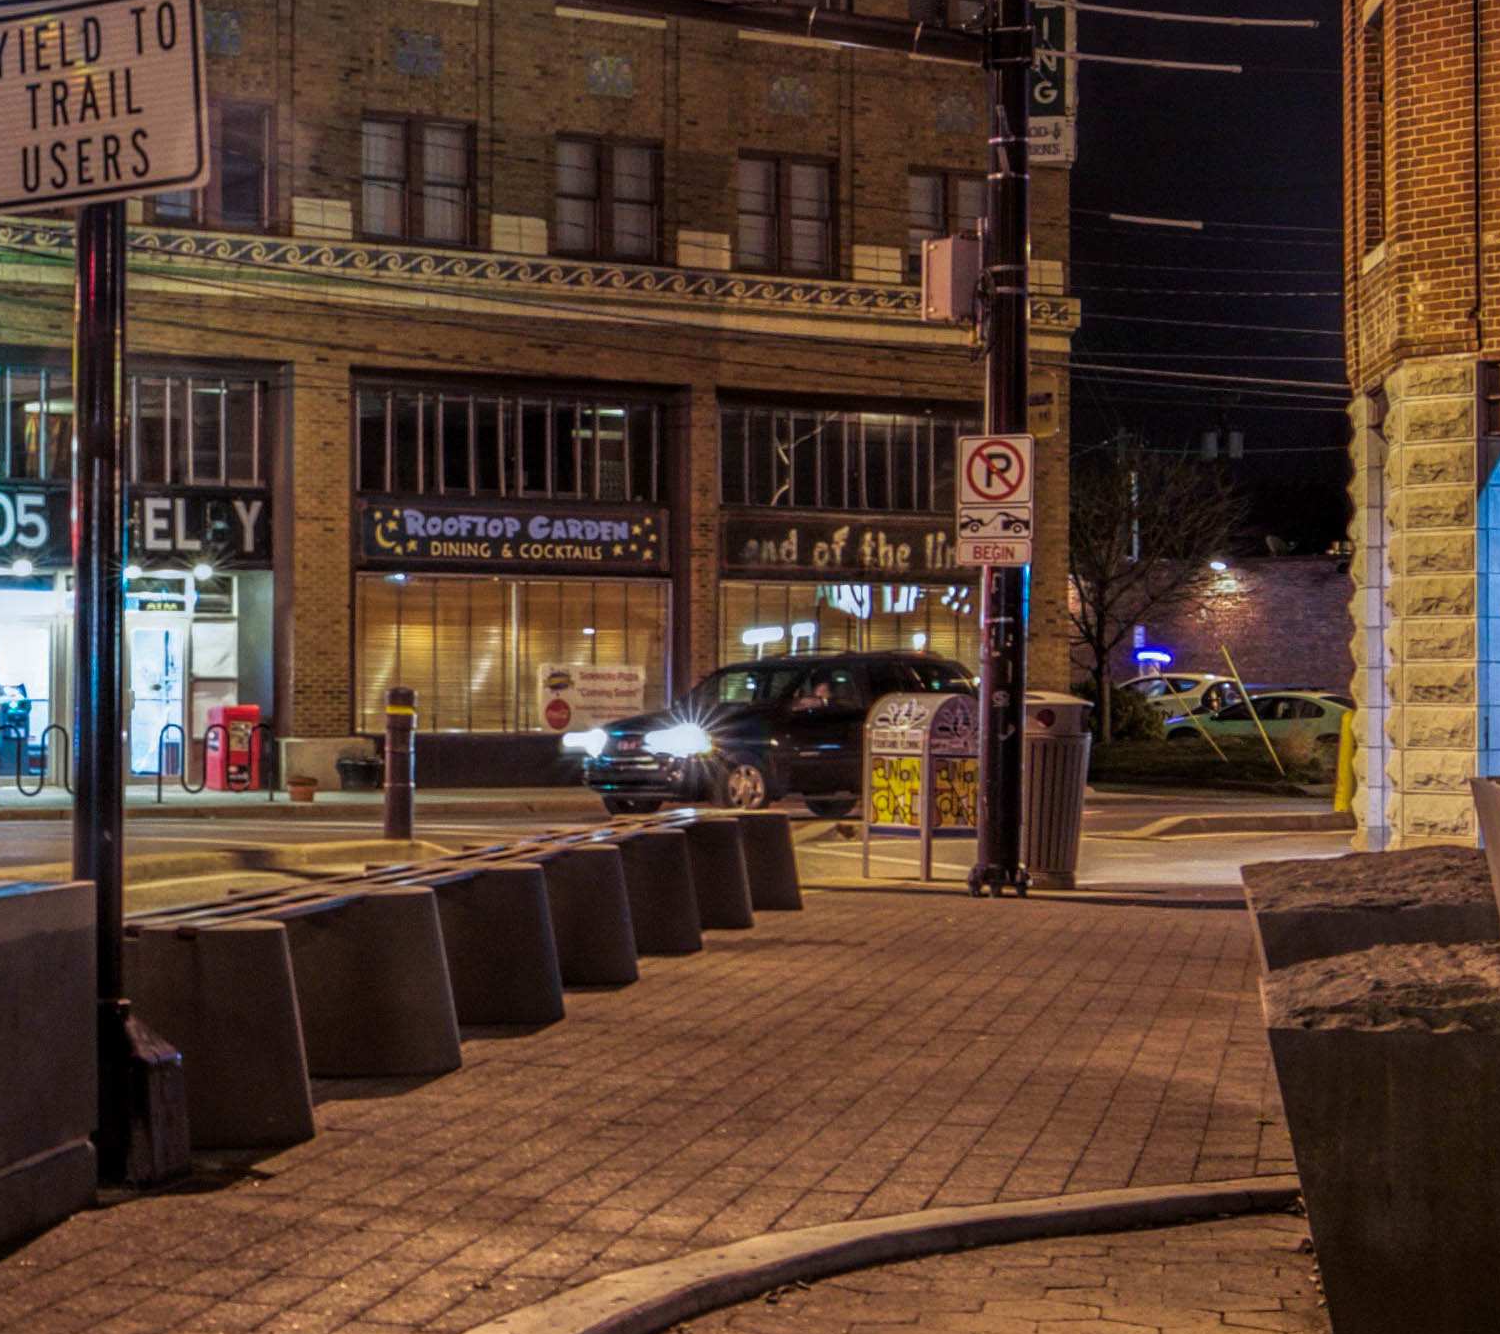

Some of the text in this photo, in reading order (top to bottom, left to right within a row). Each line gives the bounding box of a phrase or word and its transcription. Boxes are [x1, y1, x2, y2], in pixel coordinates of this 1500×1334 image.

[129, 1, 177, 56] TO
[24, 68, 143, 132] TRAIL
[20, 128, 151, 194] USERS
[403, 509, 629, 541] ROOFTOP GARDEN
[813, 525, 850, 565] of
[861, 530, 913, 568] the
[429, 540, 602, 560] DINING & COCKTAILS
[972, 545, 1015, 560] BEGIN
